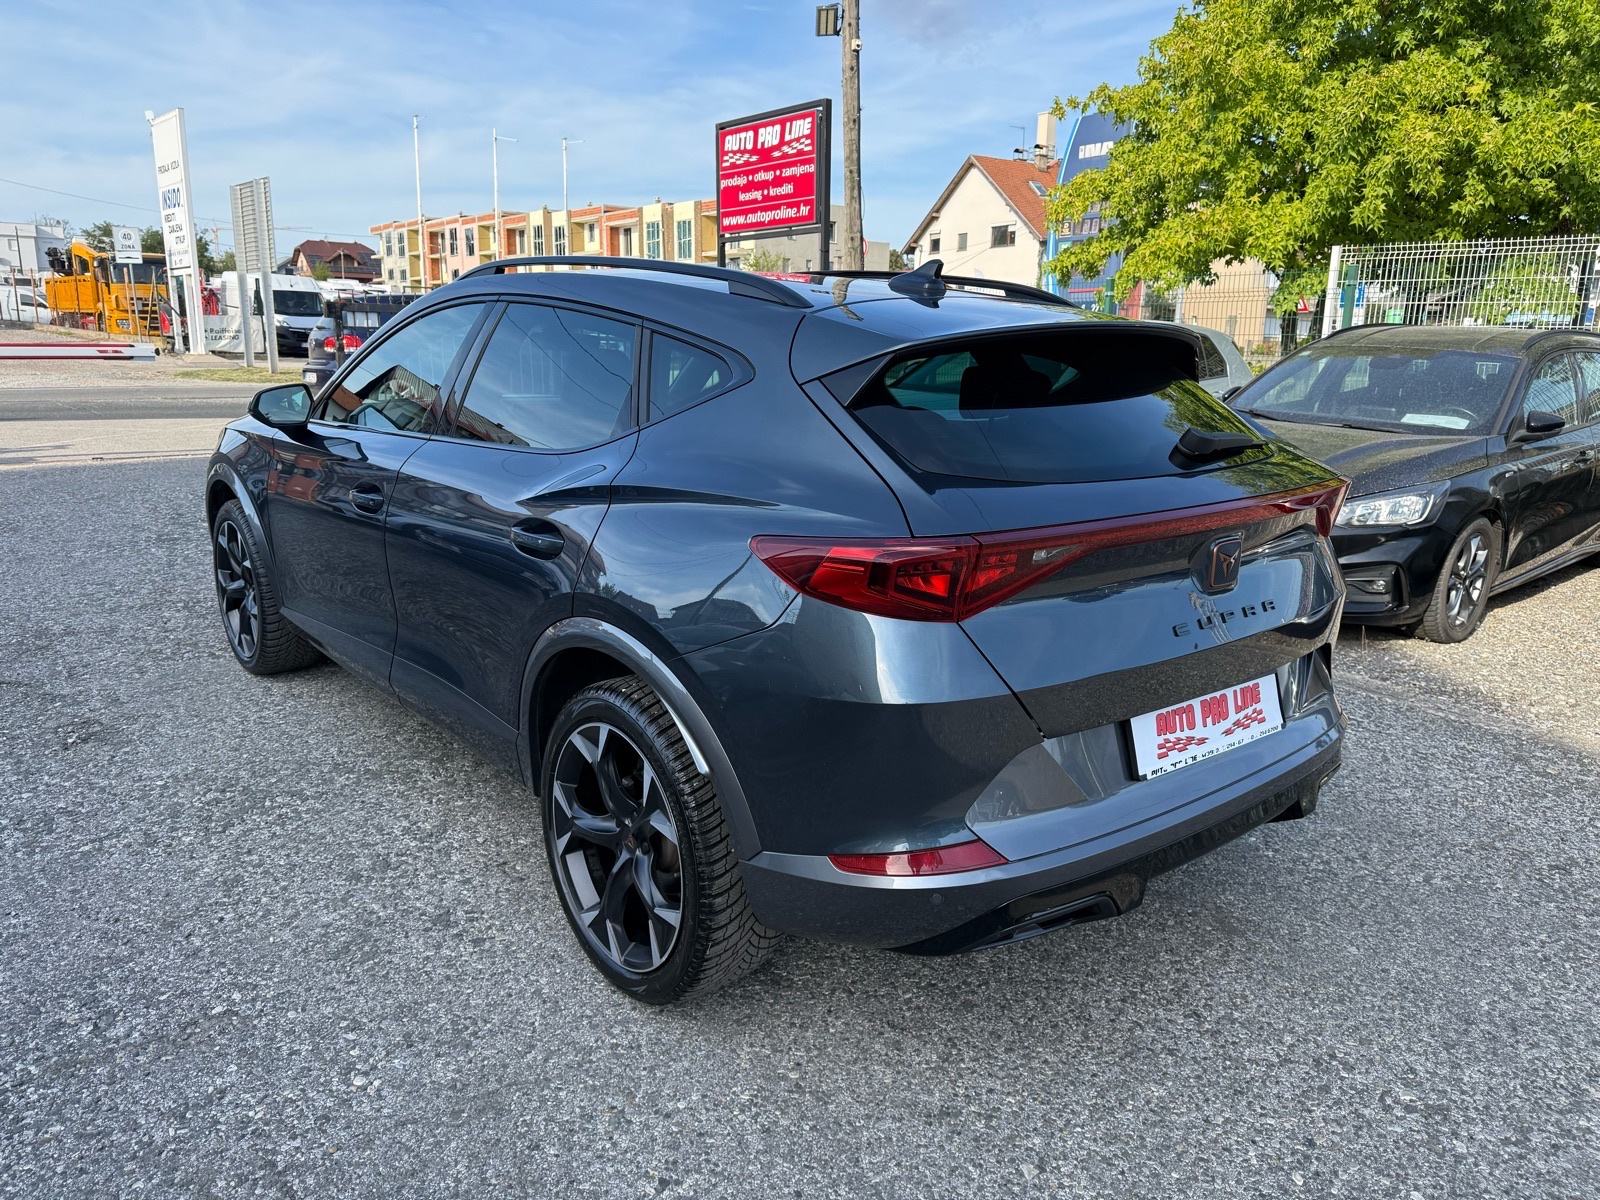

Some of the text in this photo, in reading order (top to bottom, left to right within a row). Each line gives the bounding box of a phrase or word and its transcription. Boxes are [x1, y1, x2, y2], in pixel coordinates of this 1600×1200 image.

[724, 117, 812, 151] AUTO PRO LINE
[720, 163, 815, 190] prodaja otkup zamjena
[738, 182, 794, 202] leasing krediti
[722, 203, 811, 226] www.autoproline.hr
[122, 232, 132, 241] 40
[1155, 681, 1262, 737] AUTO PRO LINE
